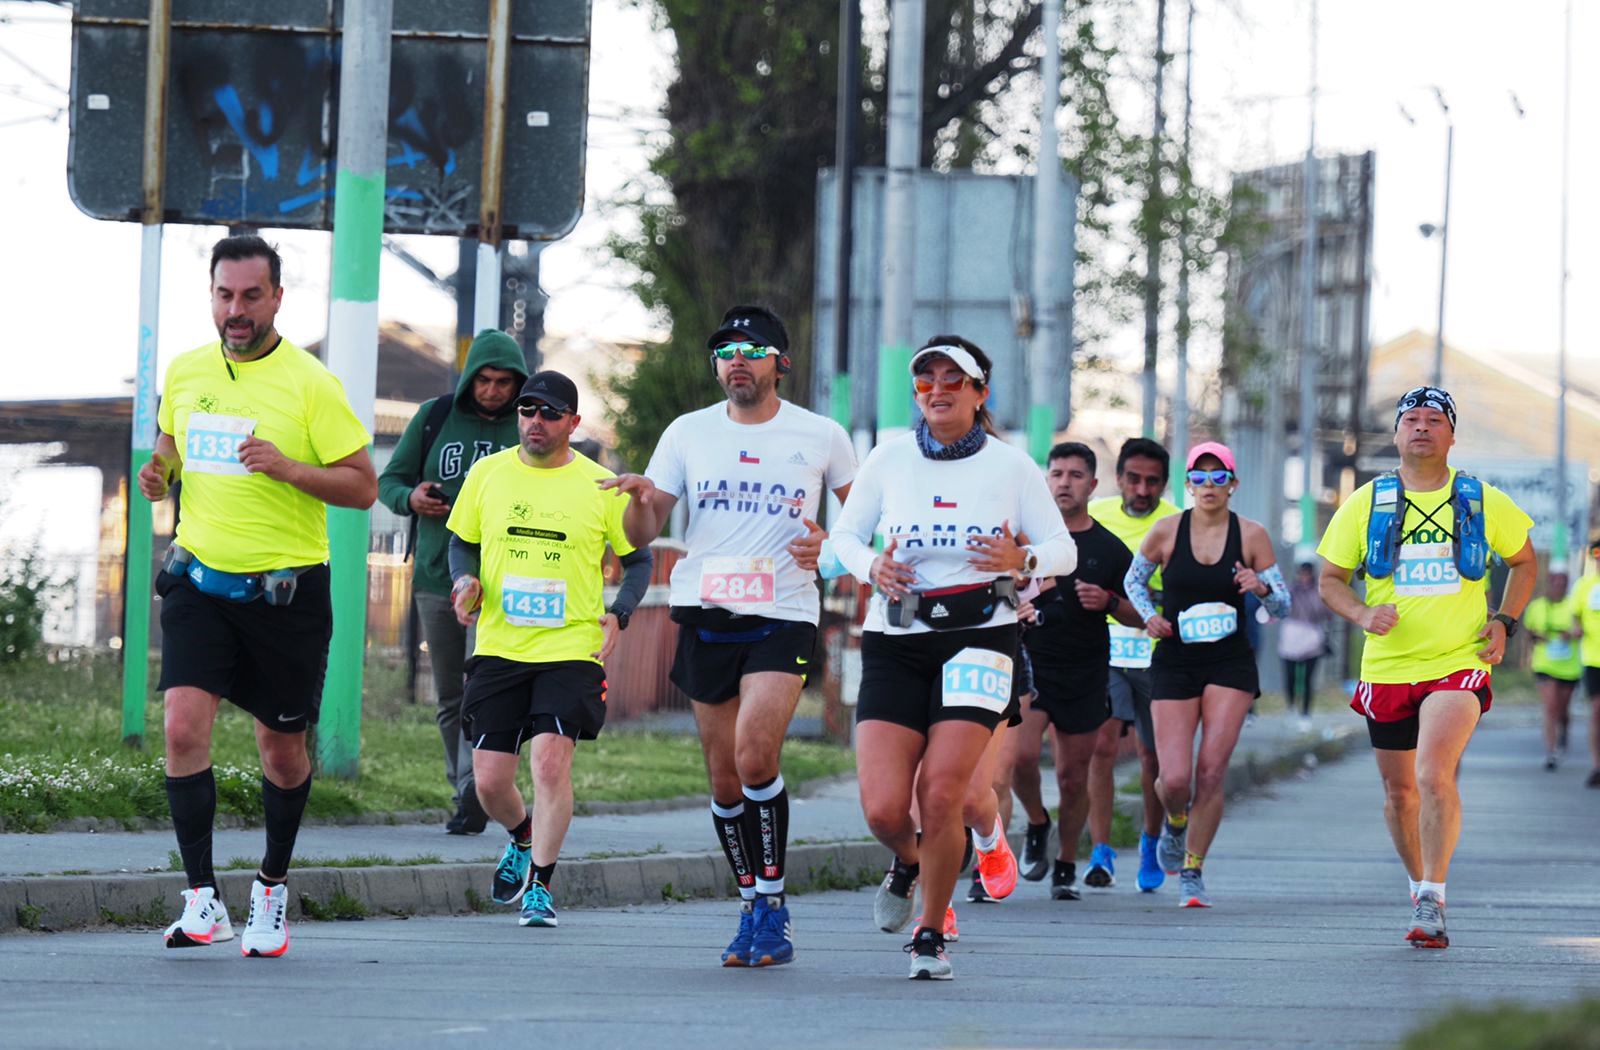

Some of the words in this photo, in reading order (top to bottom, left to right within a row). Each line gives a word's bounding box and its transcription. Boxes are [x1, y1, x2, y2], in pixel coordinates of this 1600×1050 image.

[439, 440, 508, 480] GA
[544, 551, 561, 562] VR
[1396, 561, 1458, 583] 1405
[710, 576, 765, 600] 284
[504, 592, 561, 616] 1431
[1182, 616, 1234, 638] 1080
[947, 667, 1010, 699] 1105
